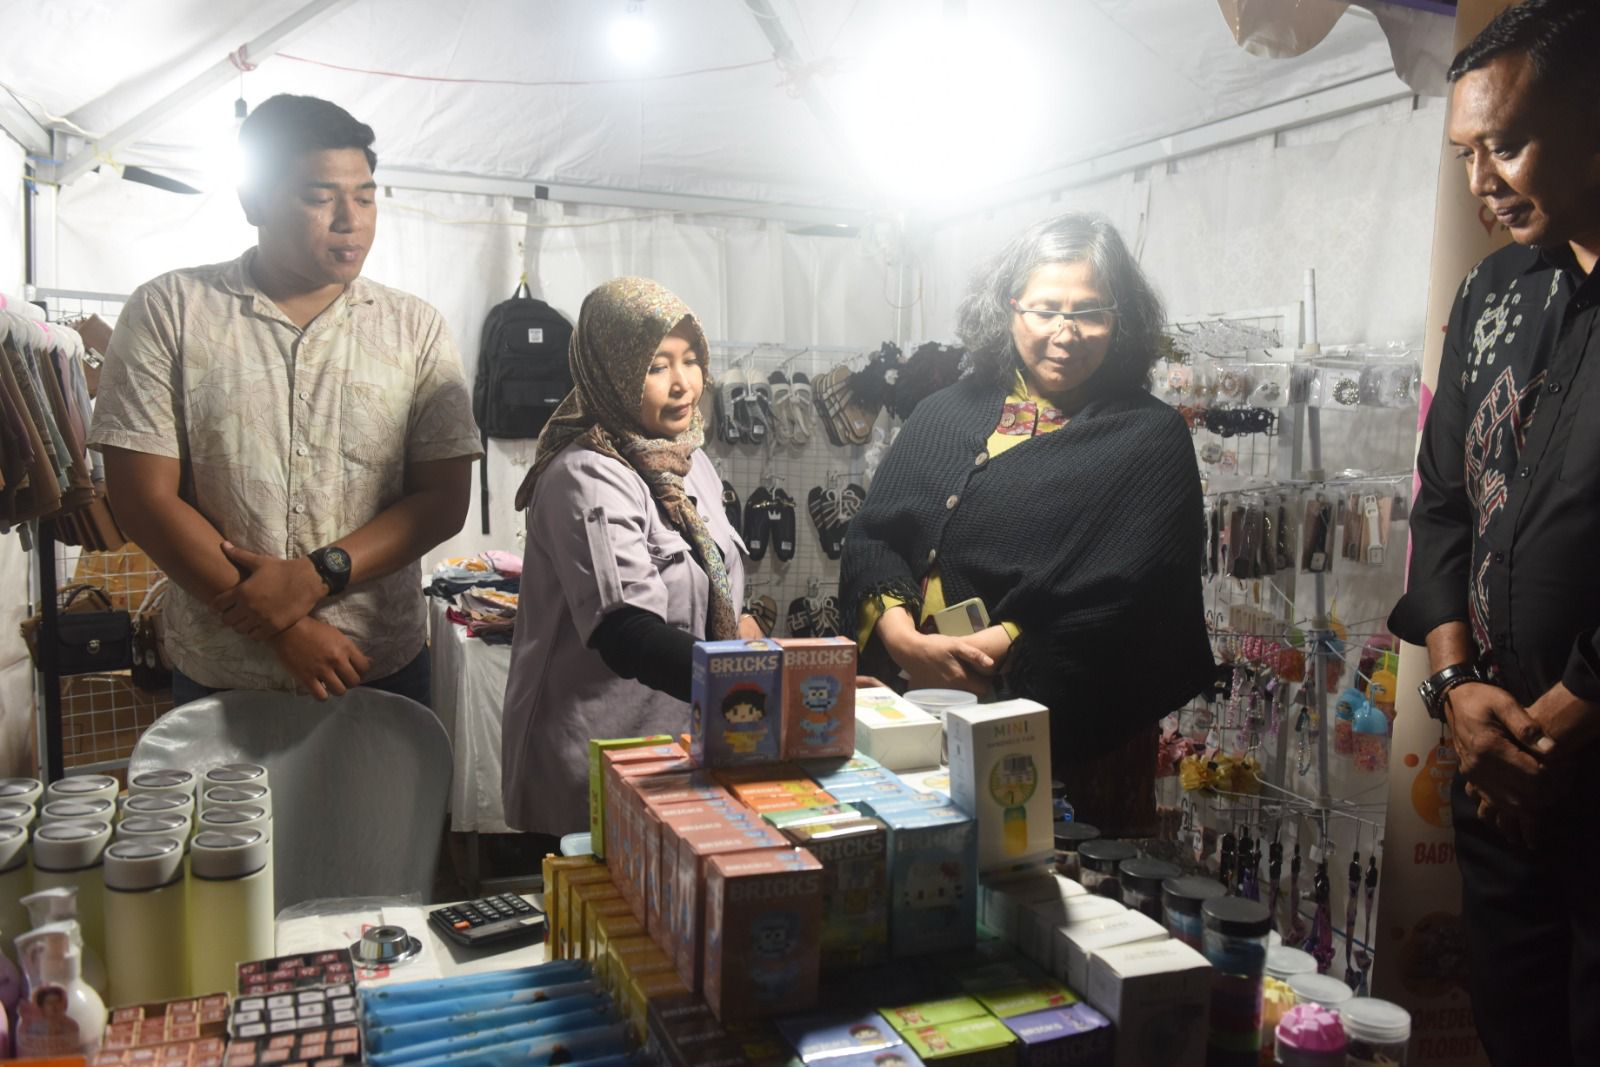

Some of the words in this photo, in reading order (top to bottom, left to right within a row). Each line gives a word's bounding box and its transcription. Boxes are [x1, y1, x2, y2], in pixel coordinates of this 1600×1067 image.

[710, 655, 779, 673] BRICKS
[784, 650, 853, 667] BRICKS
[993, 720, 1028, 737] MINI
